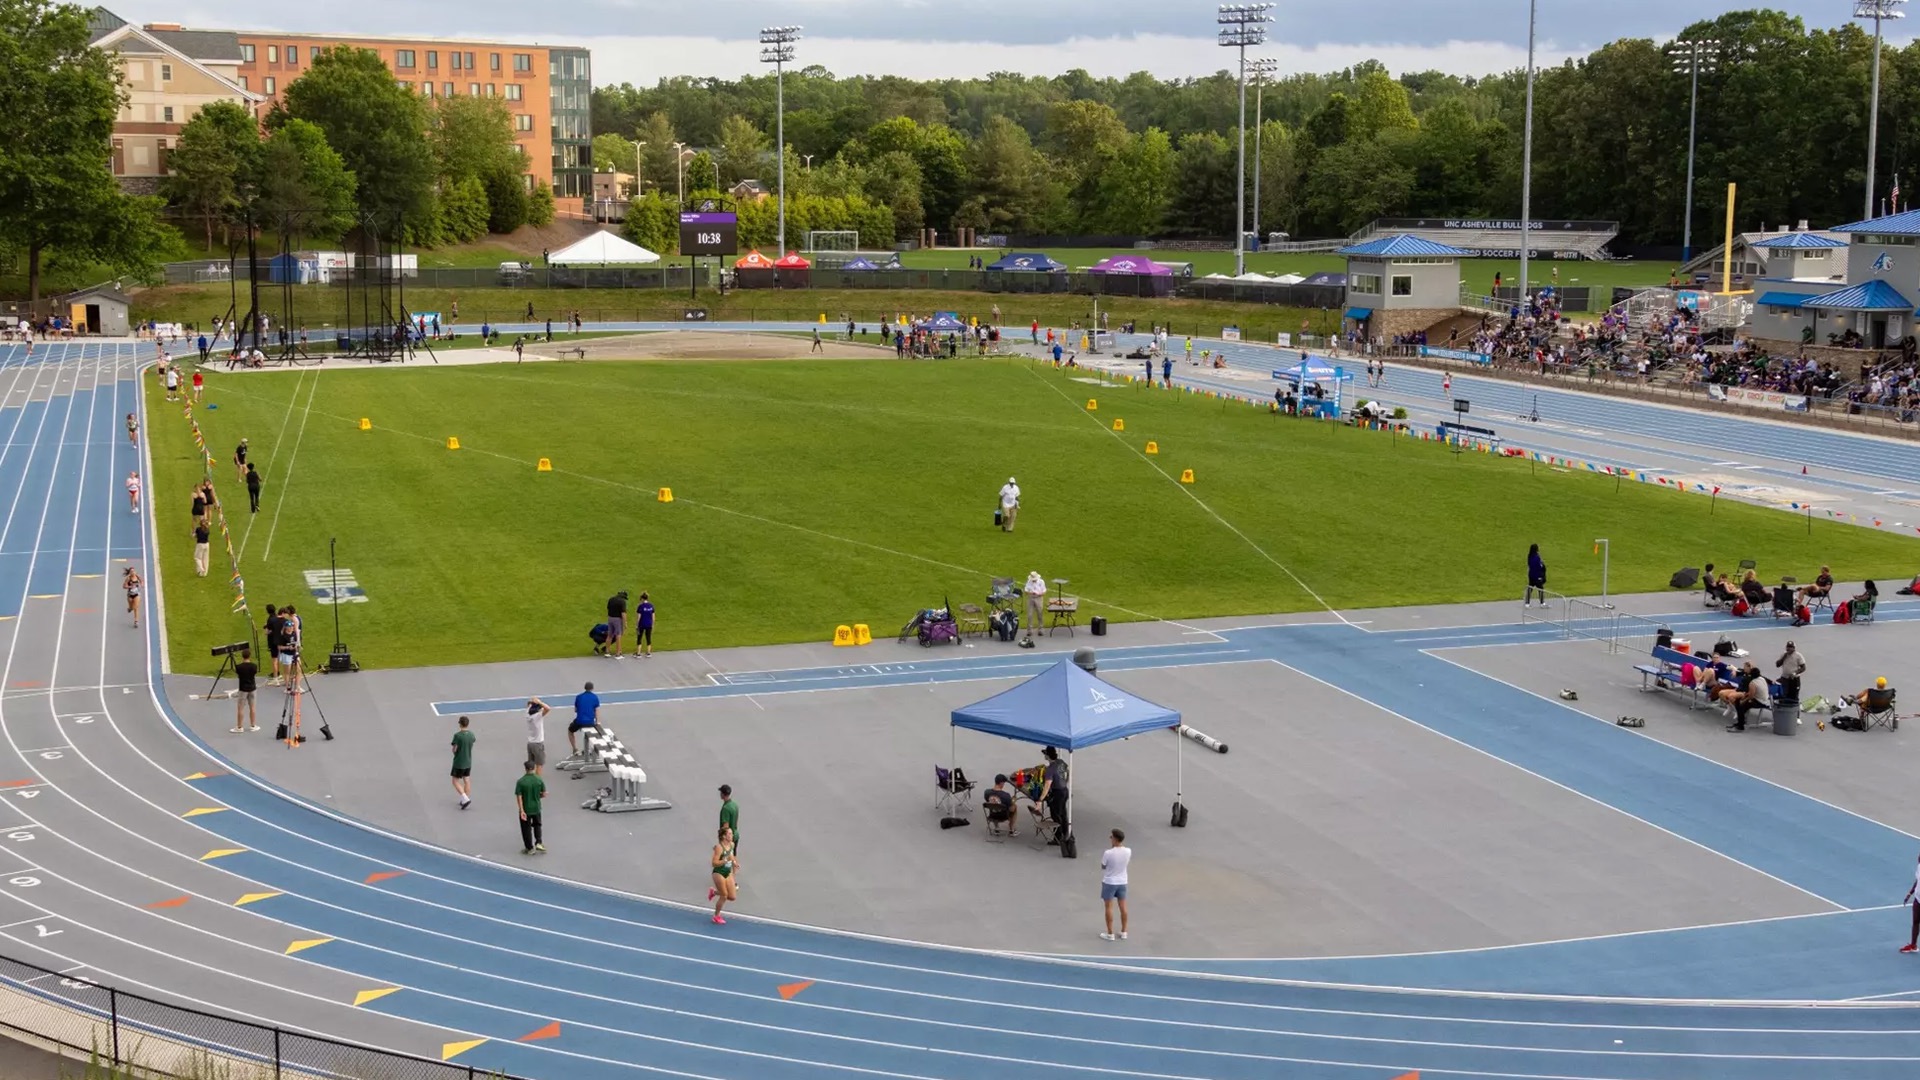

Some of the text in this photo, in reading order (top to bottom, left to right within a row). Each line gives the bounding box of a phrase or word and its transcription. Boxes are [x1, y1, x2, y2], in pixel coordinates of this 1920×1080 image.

[1444, 220, 1460, 228] UNC
[1461, 221, 1501, 229] ASHEVILLE
[697, 232, 721, 244] 10:38
